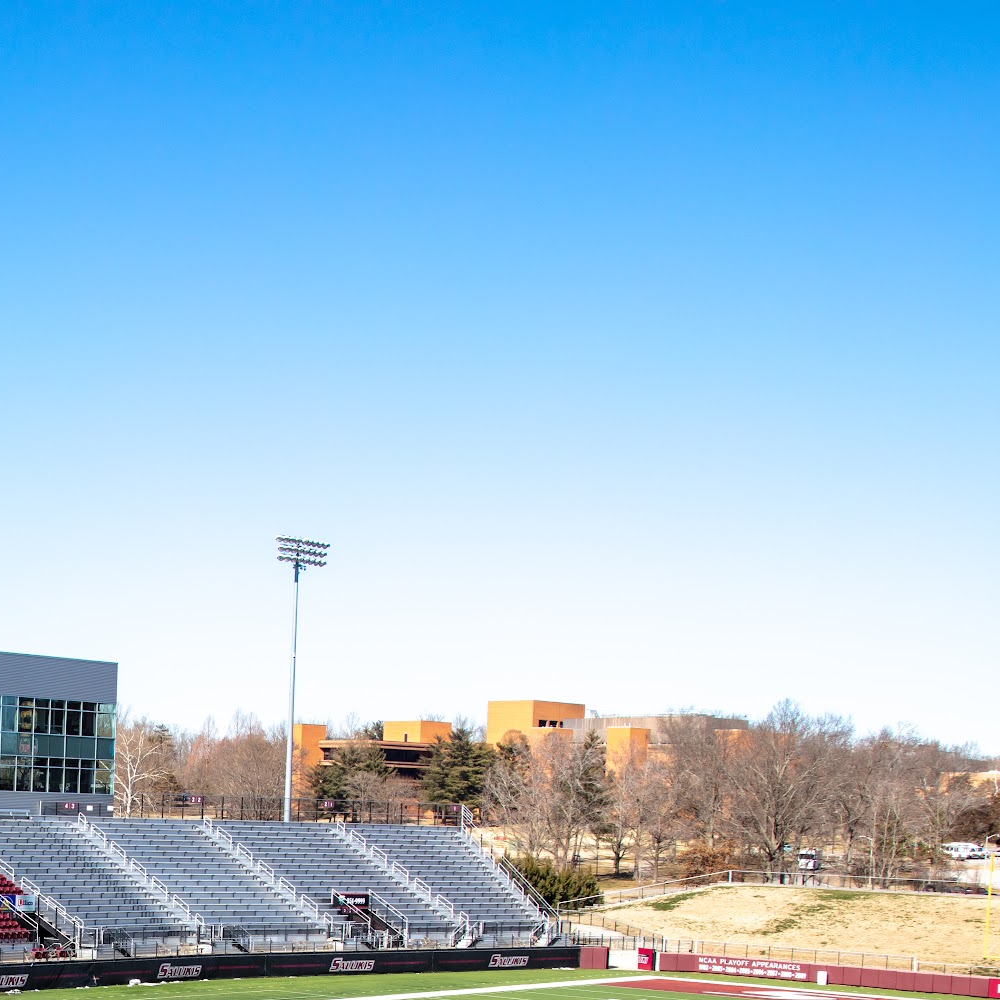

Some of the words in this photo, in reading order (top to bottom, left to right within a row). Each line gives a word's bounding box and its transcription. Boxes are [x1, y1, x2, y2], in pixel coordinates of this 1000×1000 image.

[329, 957, 376, 972] SALUKIS
[488, 953, 530, 968] SALUKIS
[720, 958, 750, 966] PLAYOFF
[751, 960, 801, 971] APPEARANCES
[156, 962, 203, 980] SALUKIS
